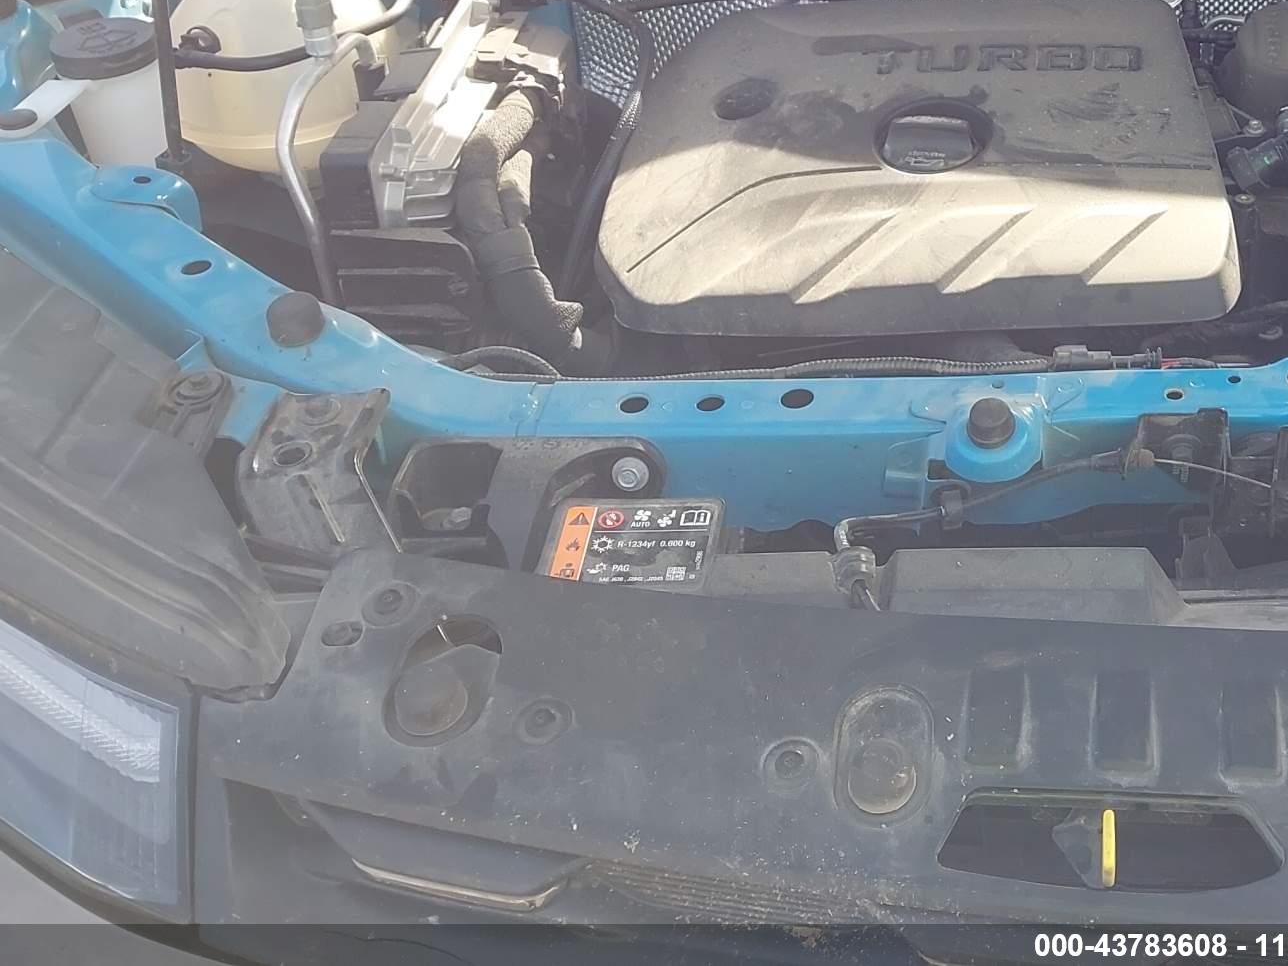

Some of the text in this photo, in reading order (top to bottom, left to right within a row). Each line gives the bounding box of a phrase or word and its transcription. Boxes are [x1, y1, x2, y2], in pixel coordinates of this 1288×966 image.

[862, 44, 1142, 74] TURBO
[617, 540, 656, 549] R-1234yf
[684, 540, 696, 548] kg
[612, 564, 630, 572] PAG
